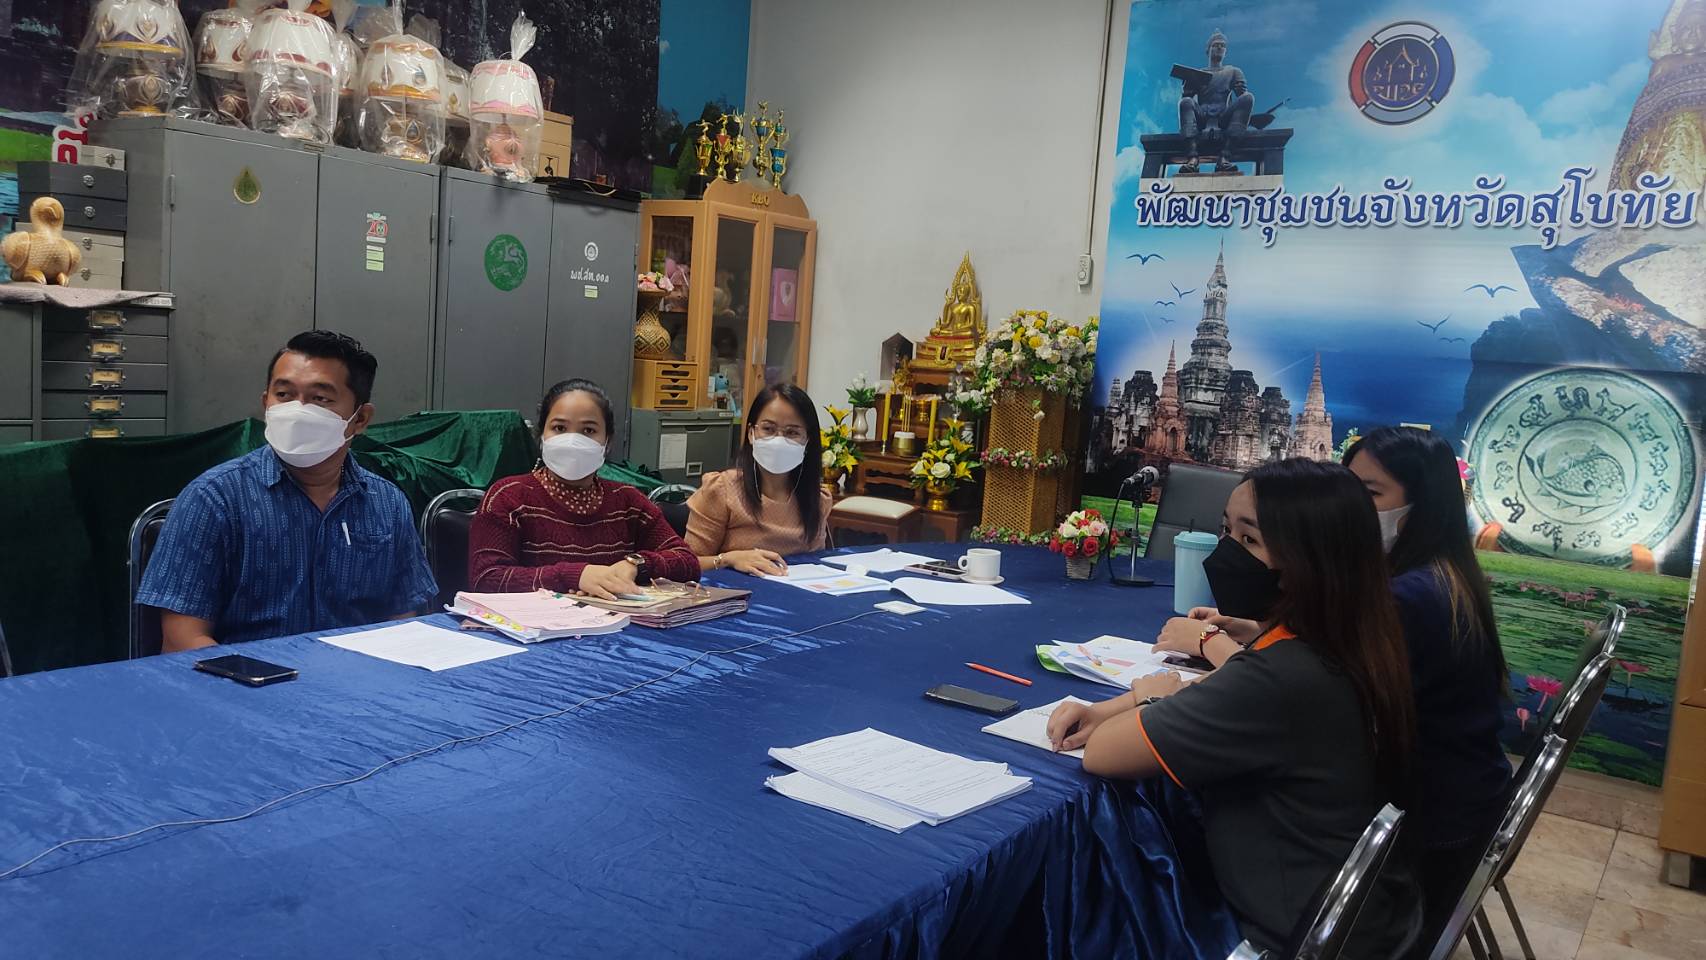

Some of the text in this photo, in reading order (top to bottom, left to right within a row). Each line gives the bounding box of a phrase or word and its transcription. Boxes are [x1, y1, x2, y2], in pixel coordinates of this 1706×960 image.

[1135, 166, 1696, 246] พัฒนาชุมชนจังหวัดสุโขทัย
